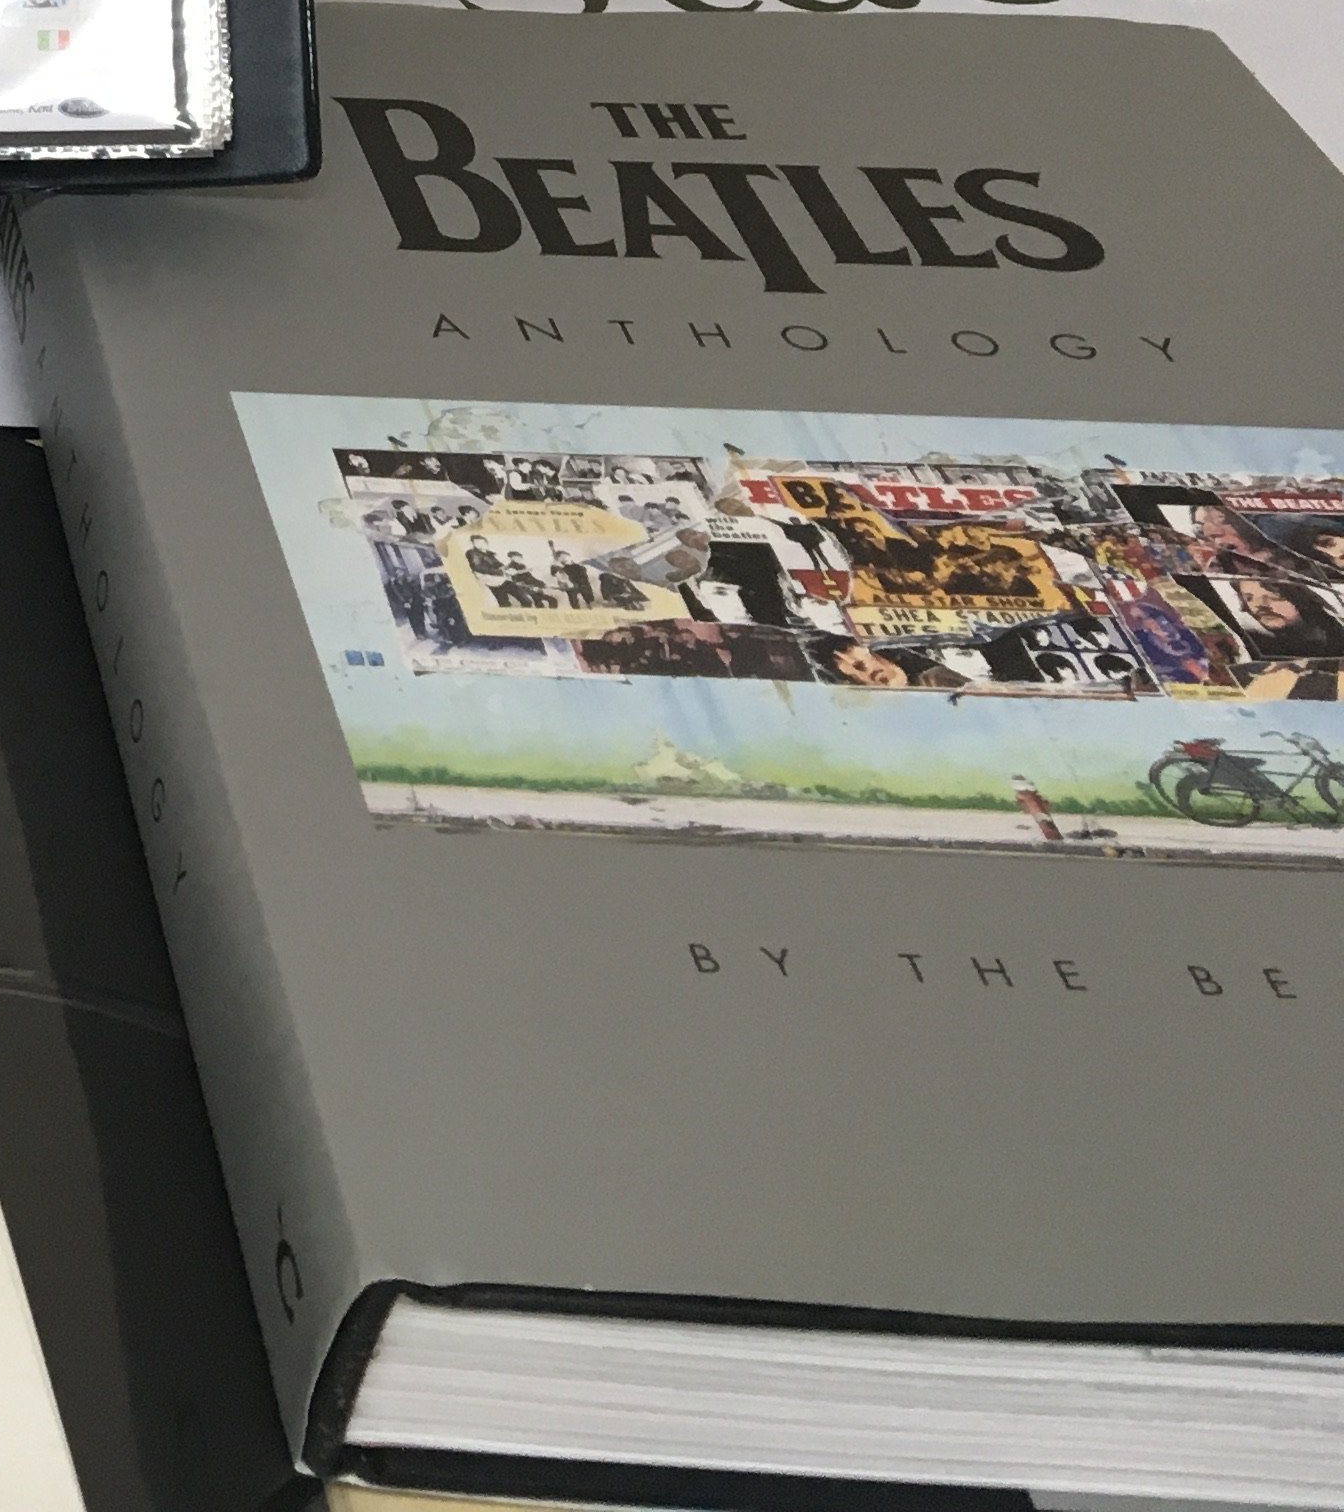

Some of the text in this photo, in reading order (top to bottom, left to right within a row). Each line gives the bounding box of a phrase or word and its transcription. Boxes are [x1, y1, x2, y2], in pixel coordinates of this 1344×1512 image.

[590, 101, 747, 140] THE
[335, 97, 1106, 295] BEATLES
[431, 313, 1179, 363] ANTHOLOGY
[872, 594, 1045, 608] ALL STAR SHOW
[879, 608, 943, 623] SHEA
[688, 942, 1087, 991] BY THE
